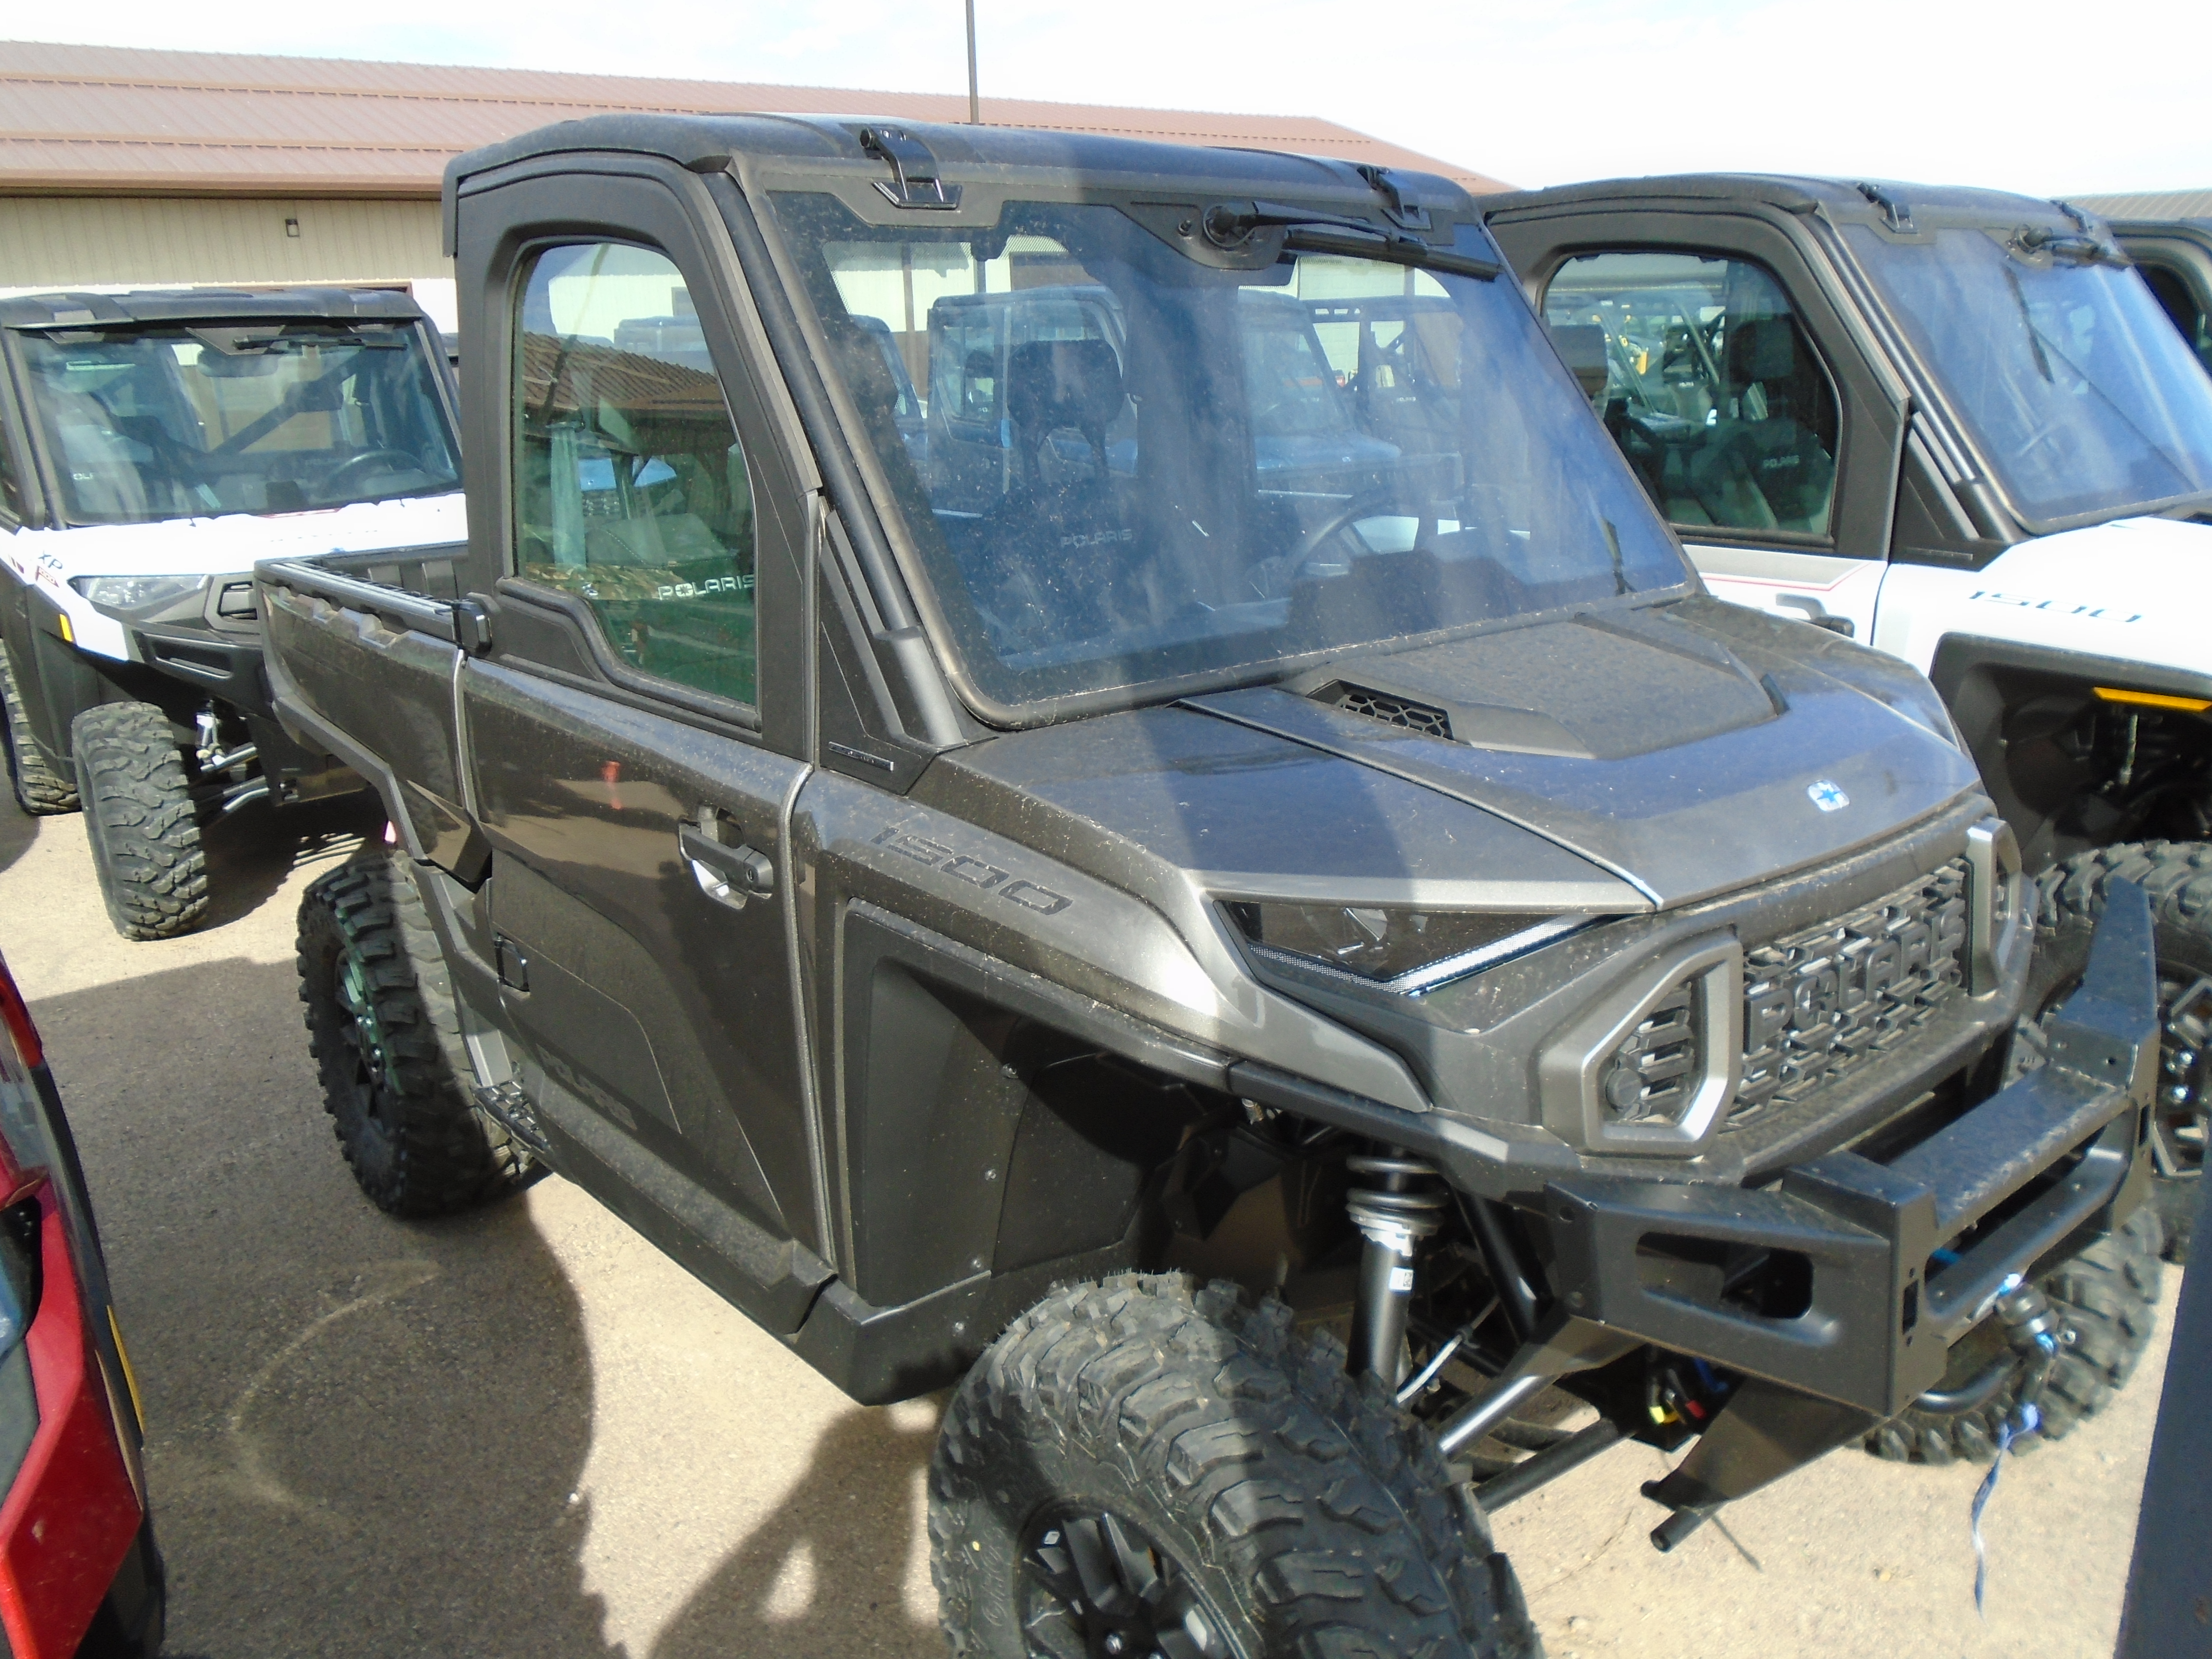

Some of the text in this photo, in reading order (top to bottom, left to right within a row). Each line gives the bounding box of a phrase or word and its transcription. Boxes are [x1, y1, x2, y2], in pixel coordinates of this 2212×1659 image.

[1060, 529, 1133, 548] POLARIS
[658, 574, 754, 600] POLARIS
[1969, 590, 2142, 623] 1500
[870, 826, 1074, 915] 1500
[1748, 897, 1966, 1054] POLARIS
